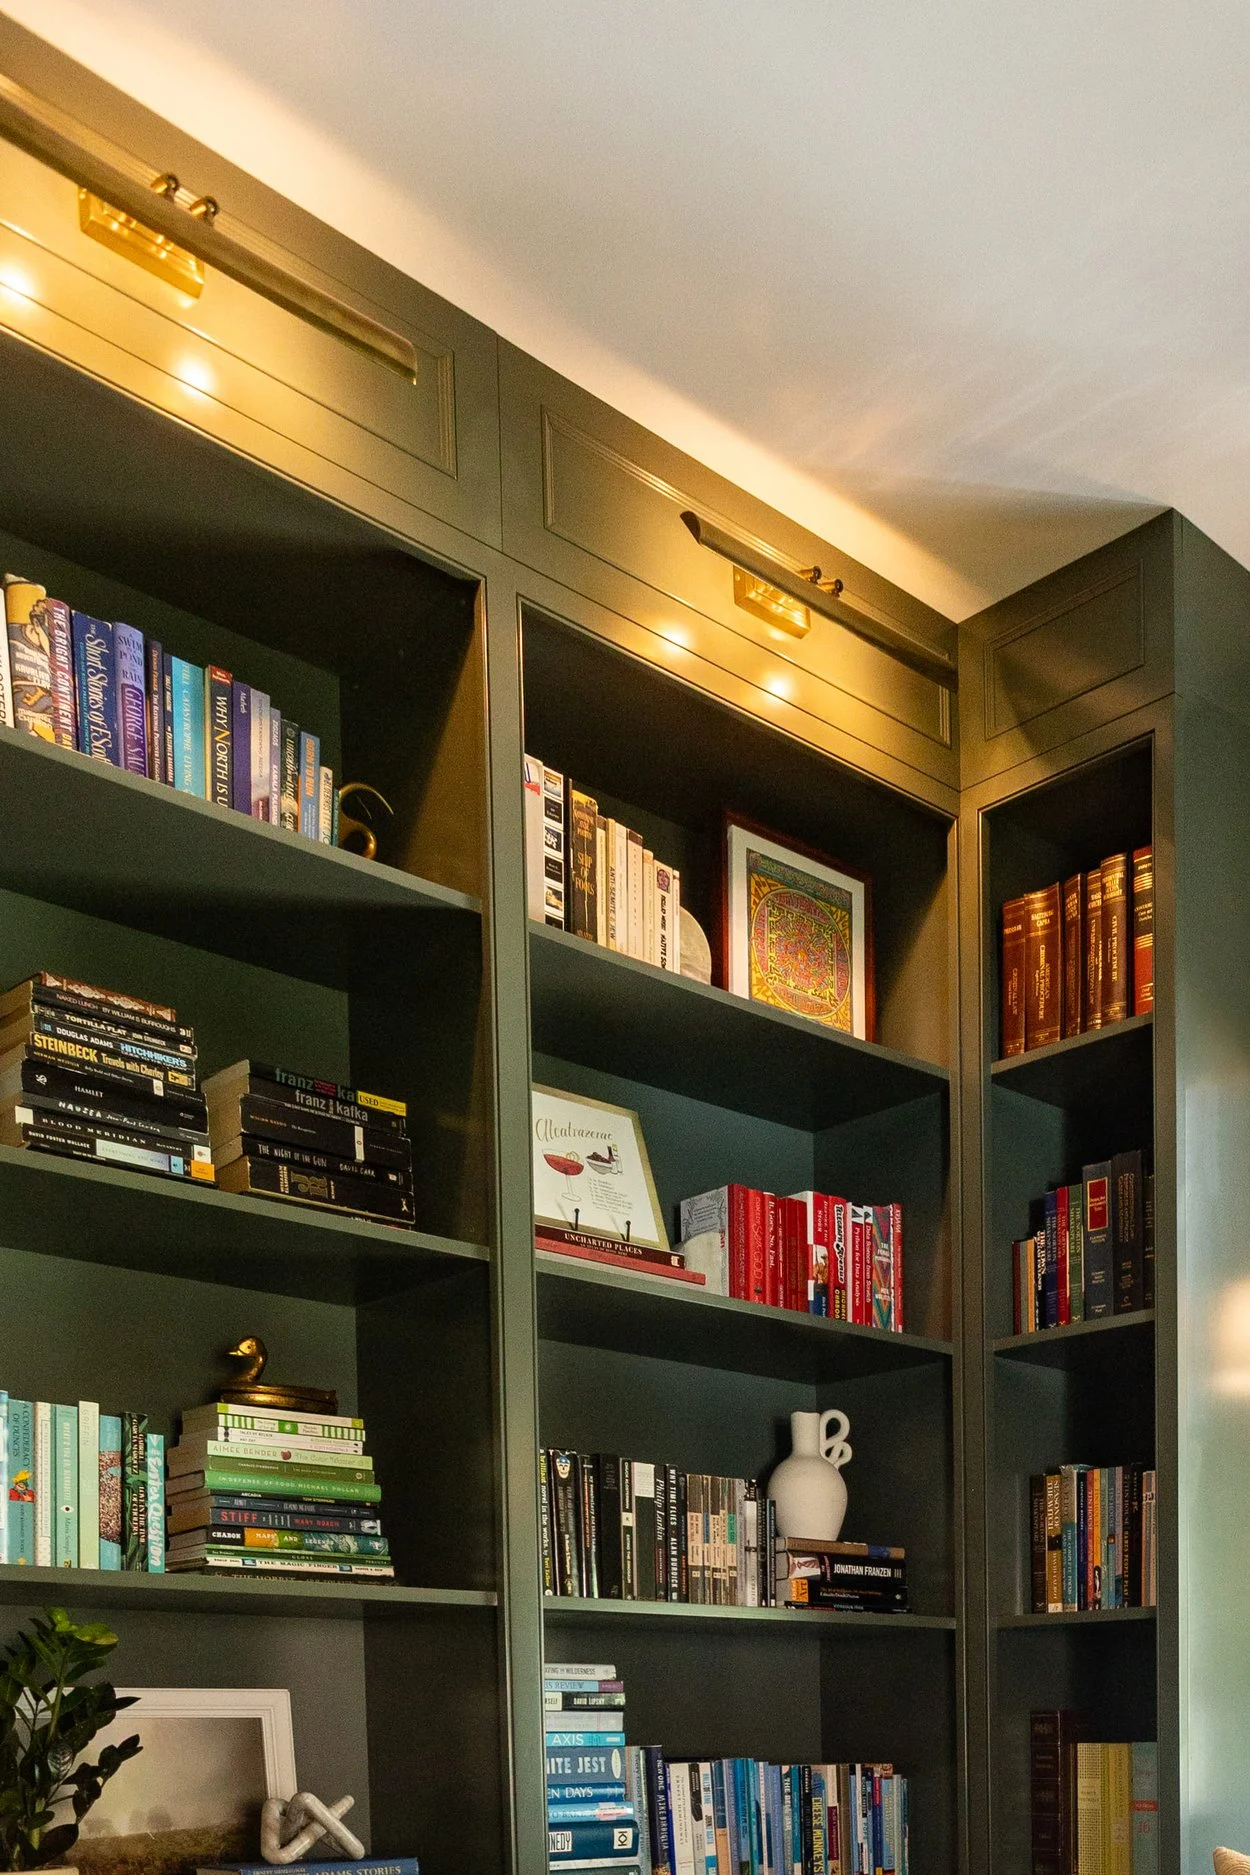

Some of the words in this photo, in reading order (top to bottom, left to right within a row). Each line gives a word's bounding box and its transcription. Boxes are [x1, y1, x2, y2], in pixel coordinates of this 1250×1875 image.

[53, 607, 66, 629] THE
[55, 630, 68, 668] BRIGHT
[85, 633, 109, 672] Short
[118, 635, 143, 651] SWIM
[122, 669, 142, 685] RAIN
[181, 664, 189, 686] FULL
[87, 668, 112, 711] Stories
[57, 671, 72, 732] CONTINENT
[216, 696, 228, 728] WHY
[124, 687, 144, 743] GEORGE
[182, 689, 191, 752] CATASTROPHE
[213, 726, 230, 781] NORTH
[184, 756, 192, 785] LIVING
[305, 767, 315, 777] TO
[217, 783, 228, 795] IS
[305, 778, 315, 797] RUN
[577, 854, 593, 868] SHIP
[576, 880, 595, 896] FOOLS
[76, 999, 98, 1011] LUNCH
[111, 1008, 135, 1022] WILLIAM
[65, 1014, 105, 1031] TORTILLA
[106, 1025, 127, 1036] FLAT
[33, 1034, 98, 1063] STEINBECK
[100, 1053, 125, 1070] Travels
[126, 1060, 140, 1073] with
[140, 1064, 164, 1081] Charley
[56, 1027, 88, 1042] DOUGLAS
[90, 1035, 114, 1049] ADAMS
[119, 1042, 187, 1068] HITCHHIKER'S
[274, 1067, 314, 1091] franz
[75, 1085, 104, 1098] HAMLET
[359, 1096, 379, 1107] USED
[58, 1100, 102, 1119] NAUSEA
[295, 1090, 326, 1109] franz
[336, 1101, 368, 1121] kafka
[29, 1130, 45, 1139] DAVID
[46, 1133, 66, 1144] FOSTER
[67, 1138, 90, 1148] WALLACE
[42, 1118, 82, 1133] BLOOD
[87, 1127, 146, 1144] MERIDIAN
[258, 1144, 270, 1155] THE
[274, 1147, 291, 1159] NIGHT
[313, 1155, 327, 1167] GUN
[835, 1206, 844, 1243] TELEGRAPH
[564, 1233, 613, 1249] UNCHARTED
[614, 1243, 643, 1255] PLACES
[753, 1251, 763, 1279] GOD
[834, 1244, 845, 1283] Avenue
[12, 1413, 19, 1423] OF
[12, 1425, 21, 1457] DUNCES
[213, 1445, 240, 1453] AIMEE
[243, 1447, 277, 1457] BENDER
[540, 1455, 548, 1483] brilliant
[228, 1476, 260, 1485] DEFENSE
[298, 1483, 329, 1491] MICHAEL
[655, 1478, 664, 1508] Philip
[220, 1511, 257, 1523] STIFF
[150, 1503, 164, 1567] Question
[833, 1564, 864, 1576] JONATHAN
[864, 1566, 892, 1577] FRANZEN
[552, 1734, 584, 1745] AXIS
[577, 1757, 606, 1773] JEST
[565, 1787, 593, 1798] DAYS
[657, 1795, 666, 1814] MIKE
[812, 1797, 822, 1826] CHEESE
[659, 1817, 669, 1850] BIRBIGLIA
[812, 1829, 823, 1872] MONKEYS
